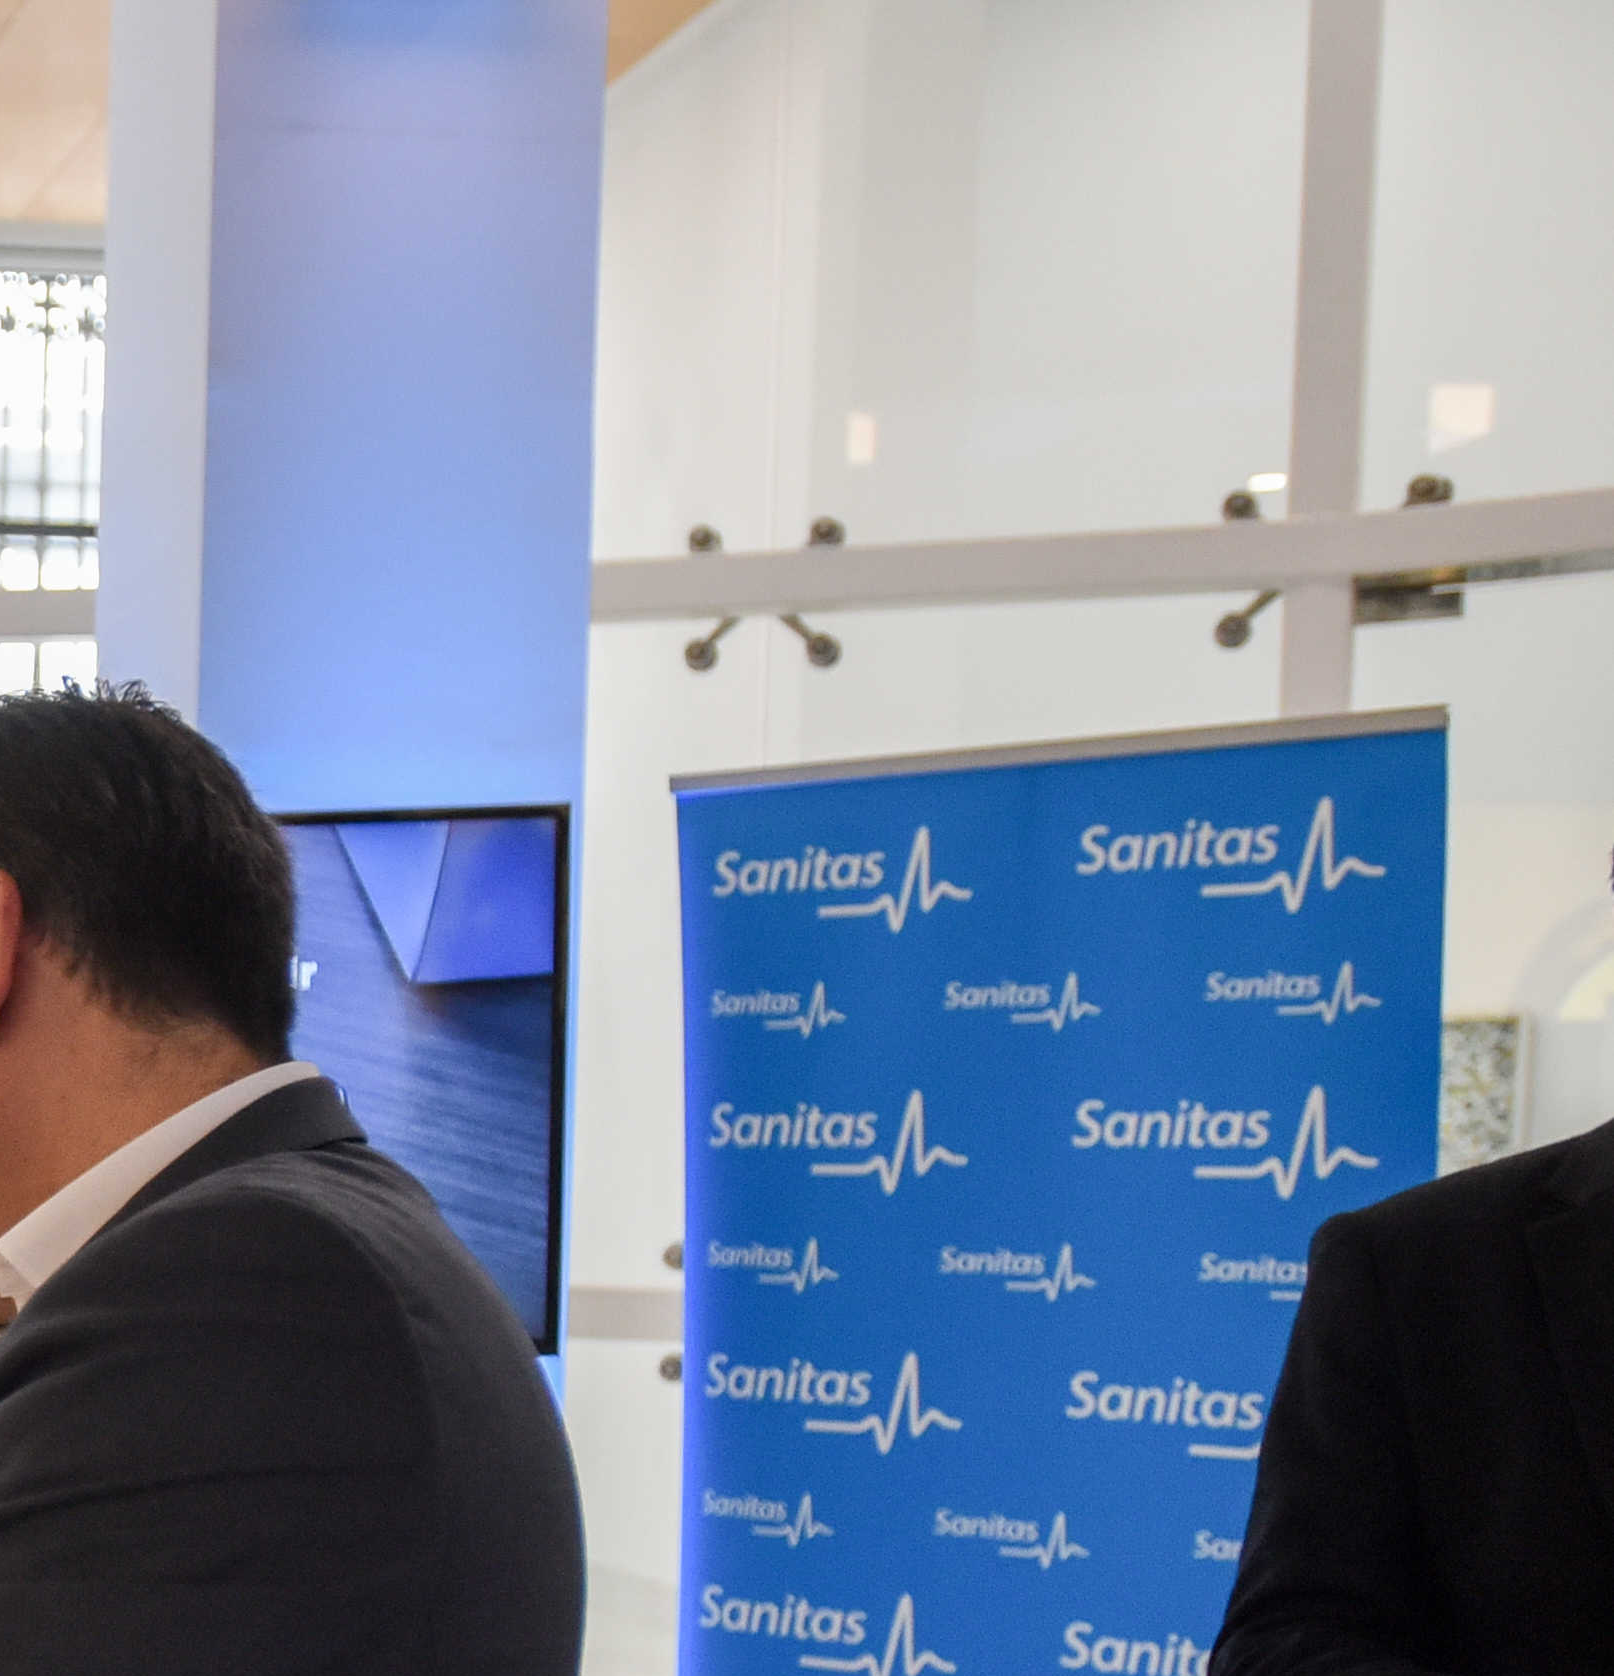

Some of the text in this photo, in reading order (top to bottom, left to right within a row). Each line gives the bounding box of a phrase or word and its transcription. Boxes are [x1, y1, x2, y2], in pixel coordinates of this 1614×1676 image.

[1075, 818, 1280, 876] Sanitas
[713, 845, 885, 896] Sanitas
[712, 990, 800, 1016] Sanitas
[944, 981, 1051, 1010] Sanitas
[1205, 970, 1321, 1001] Sanitas
[710, 1102, 878, 1149] Sanitas
[1071, 1099, 1271, 1149] Sanitas
[708, 1243, 793, 1270] Sanitas
[940, 1246, 1046, 1276] Sanitas
[706, 1354, 872, 1406] Sanitas
[1065, 1370, 1265, 1430] Sanitas
[703, 1492, 787, 1522] Sanitas
[934, 1508, 1039, 1543] Sanitas
[700, 1592, 867, 1645] Sanitas
